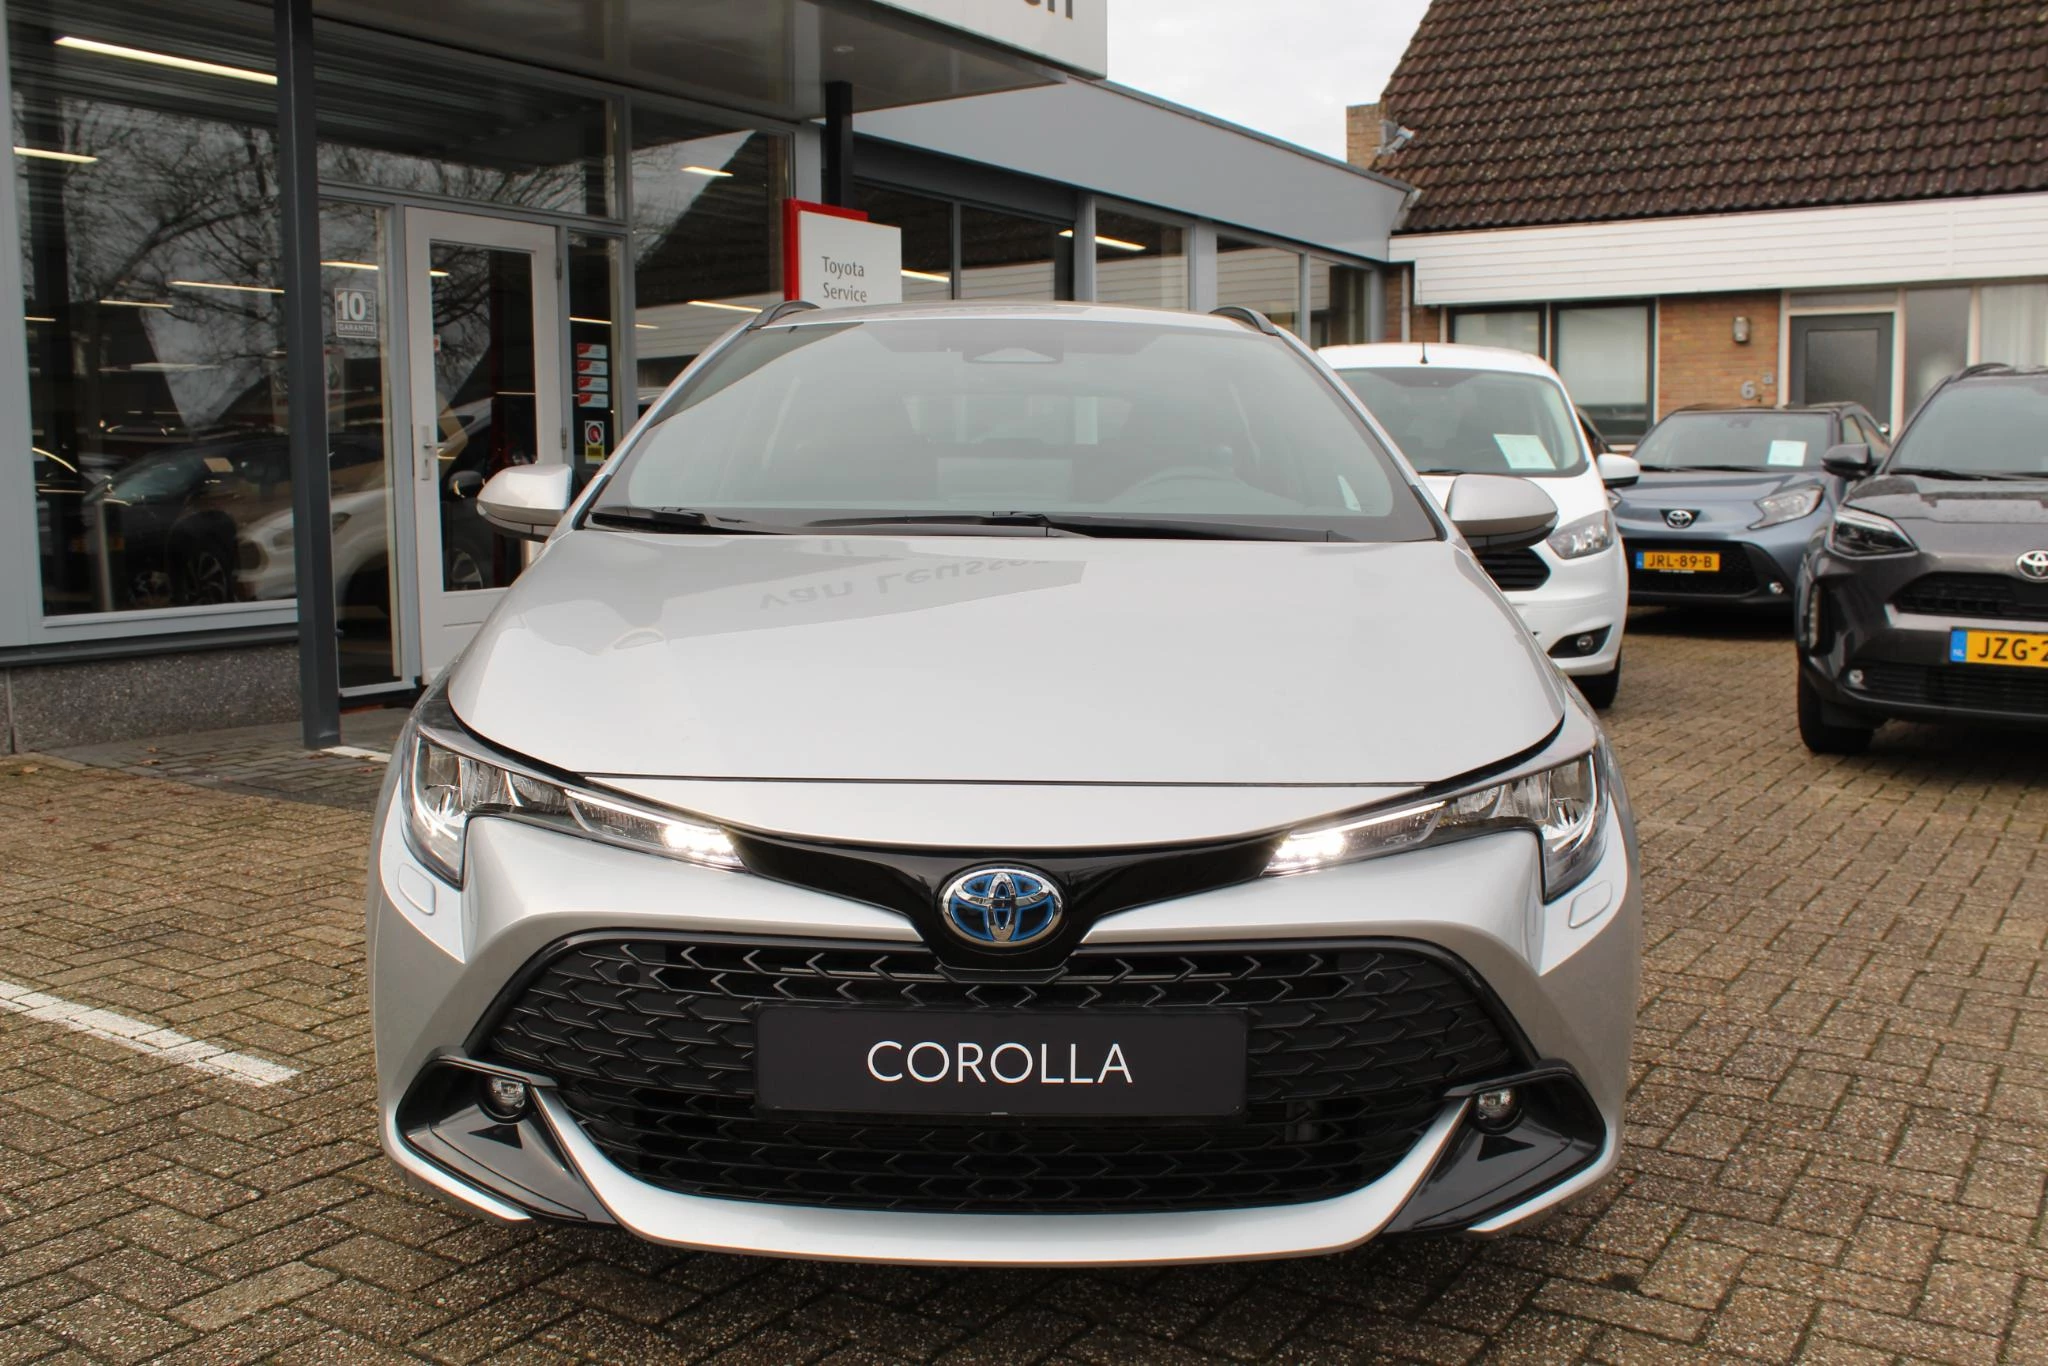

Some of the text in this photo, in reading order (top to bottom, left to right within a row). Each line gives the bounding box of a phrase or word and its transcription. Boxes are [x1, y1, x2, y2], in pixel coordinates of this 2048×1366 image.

[821, 255, 865, 280] Toyota
[823, 281, 867, 303] Service
[337, 291, 366, 320] 10
[1649, 554, 1712, 568] JRL-89-B
[867, 1040, 1133, 1084] COROLLA
